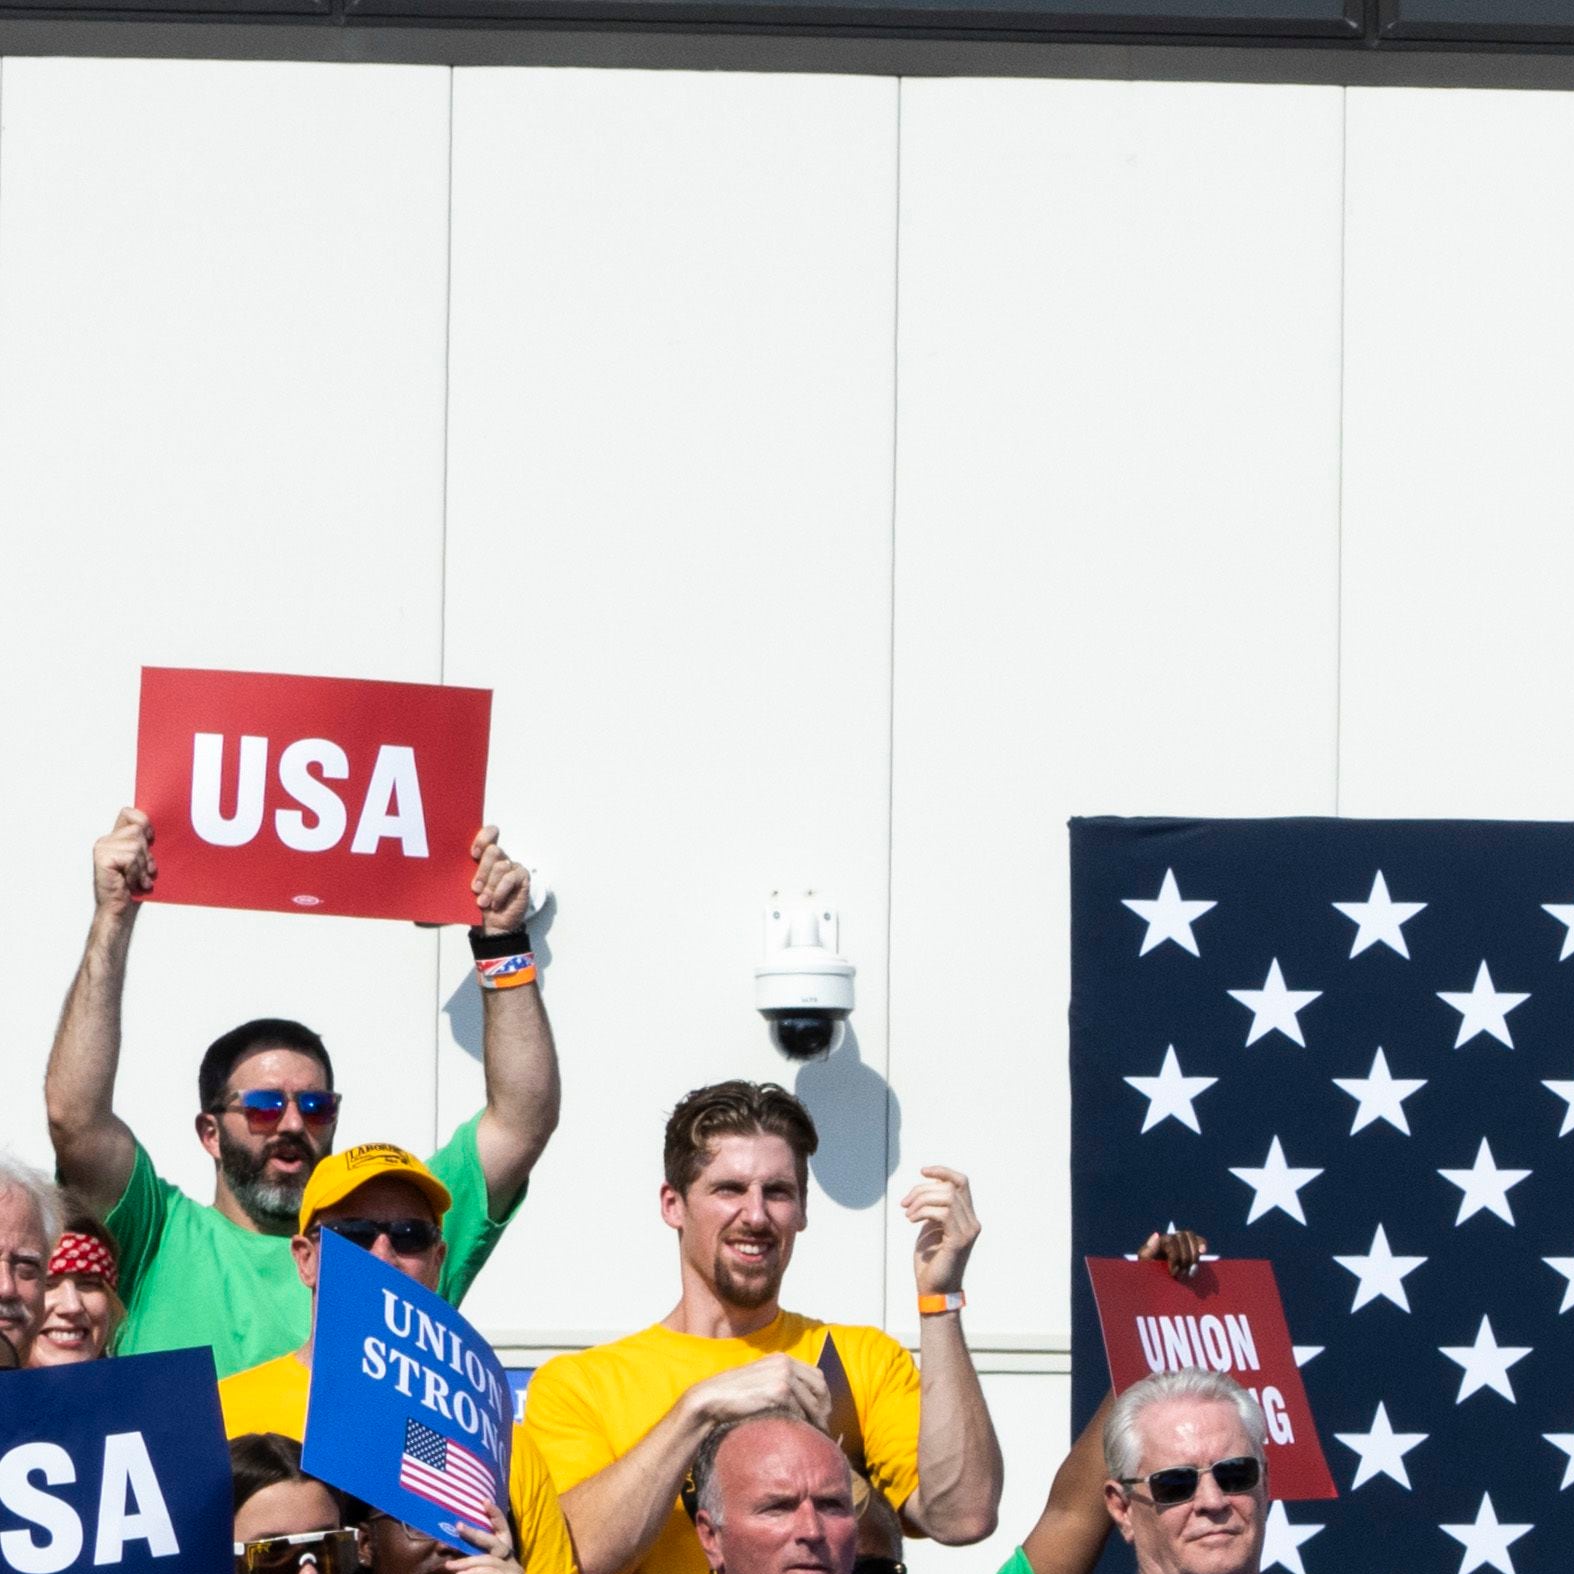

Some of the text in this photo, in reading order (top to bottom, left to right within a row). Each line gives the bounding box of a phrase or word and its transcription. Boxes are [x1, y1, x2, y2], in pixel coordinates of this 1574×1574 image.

[190, 732, 430, 859] USA
[382, 1288, 504, 1422] UNION
[1136, 1314, 1261, 1374] UNION
[362, 1336, 507, 1484] STRON
